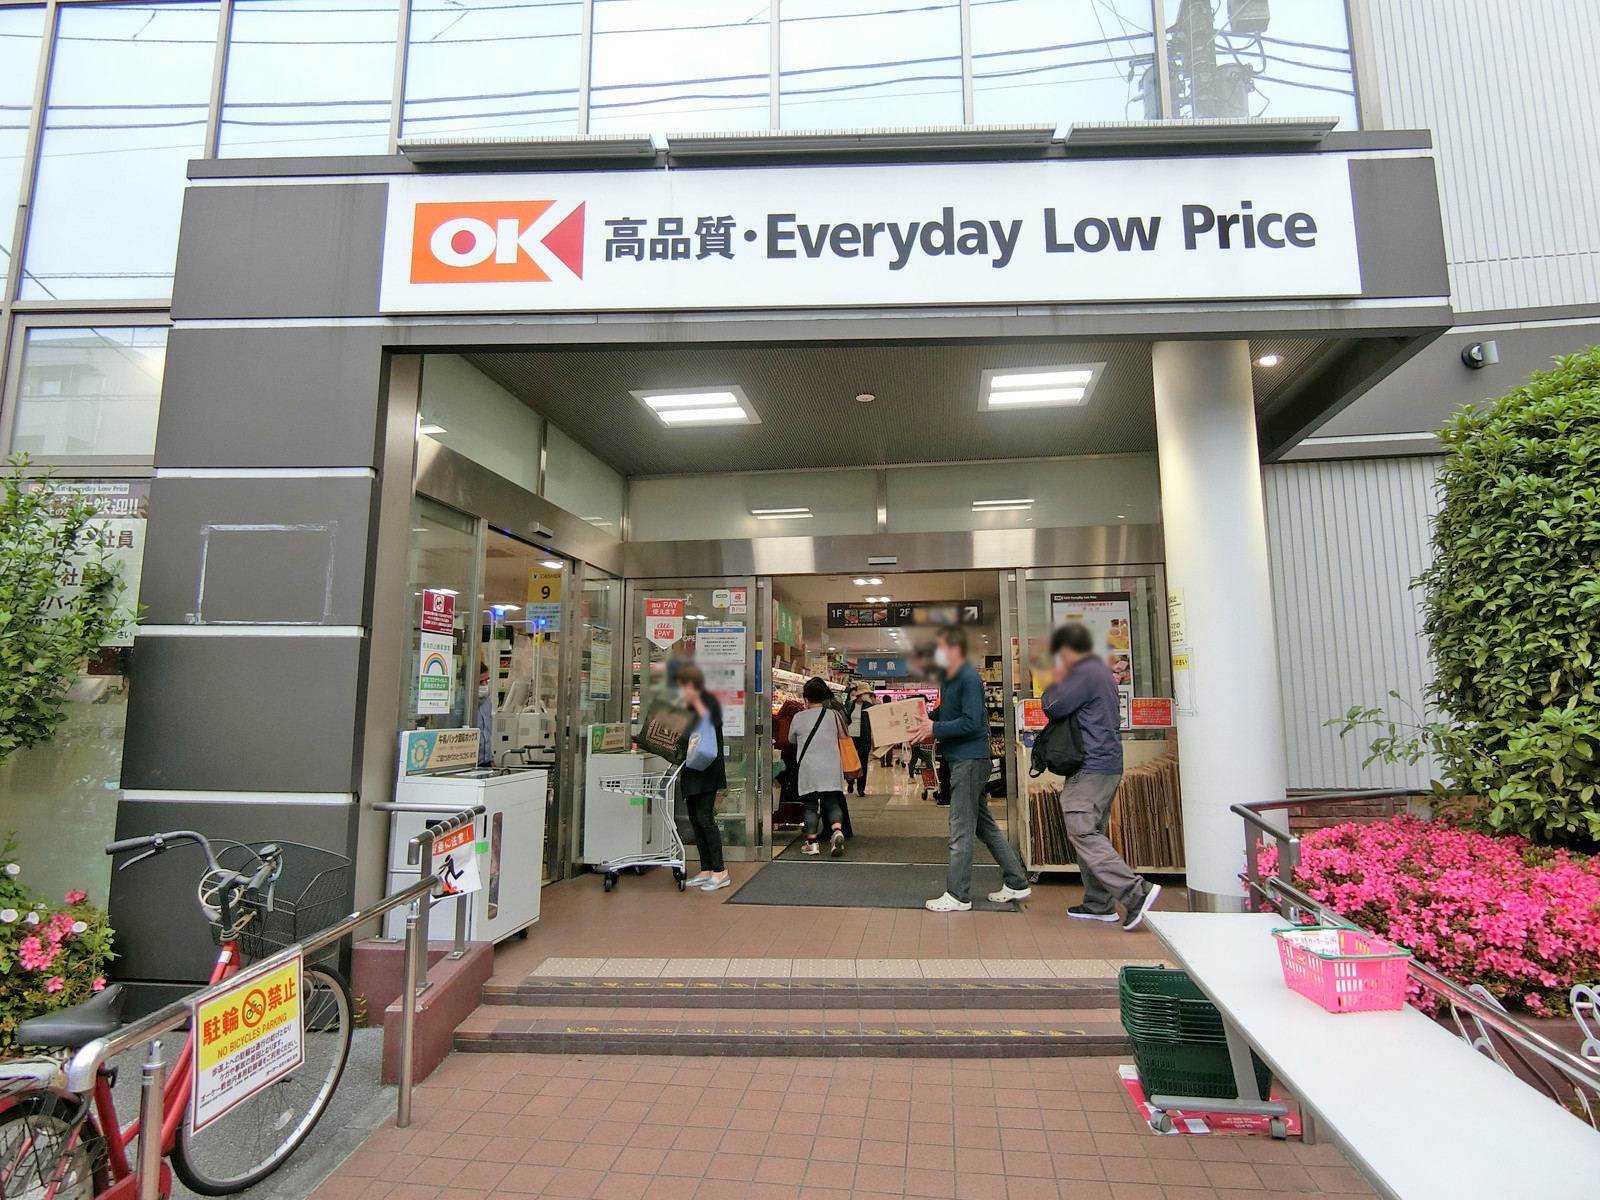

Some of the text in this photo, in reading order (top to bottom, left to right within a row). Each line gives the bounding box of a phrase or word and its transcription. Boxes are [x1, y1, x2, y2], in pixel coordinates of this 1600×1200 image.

[429, 200, 585, 281] OK
[1043, 207, 1162, 254] Low
[1182, 200, 1318, 250] Price
[541, 585, 551, 600] 9
[831, 608, 910, 618] 1F 2F
[203, 977, 297, 1047] 駐輪 禁止
[217, 1012, 287, 1059] NO BICYCLES PARKING
